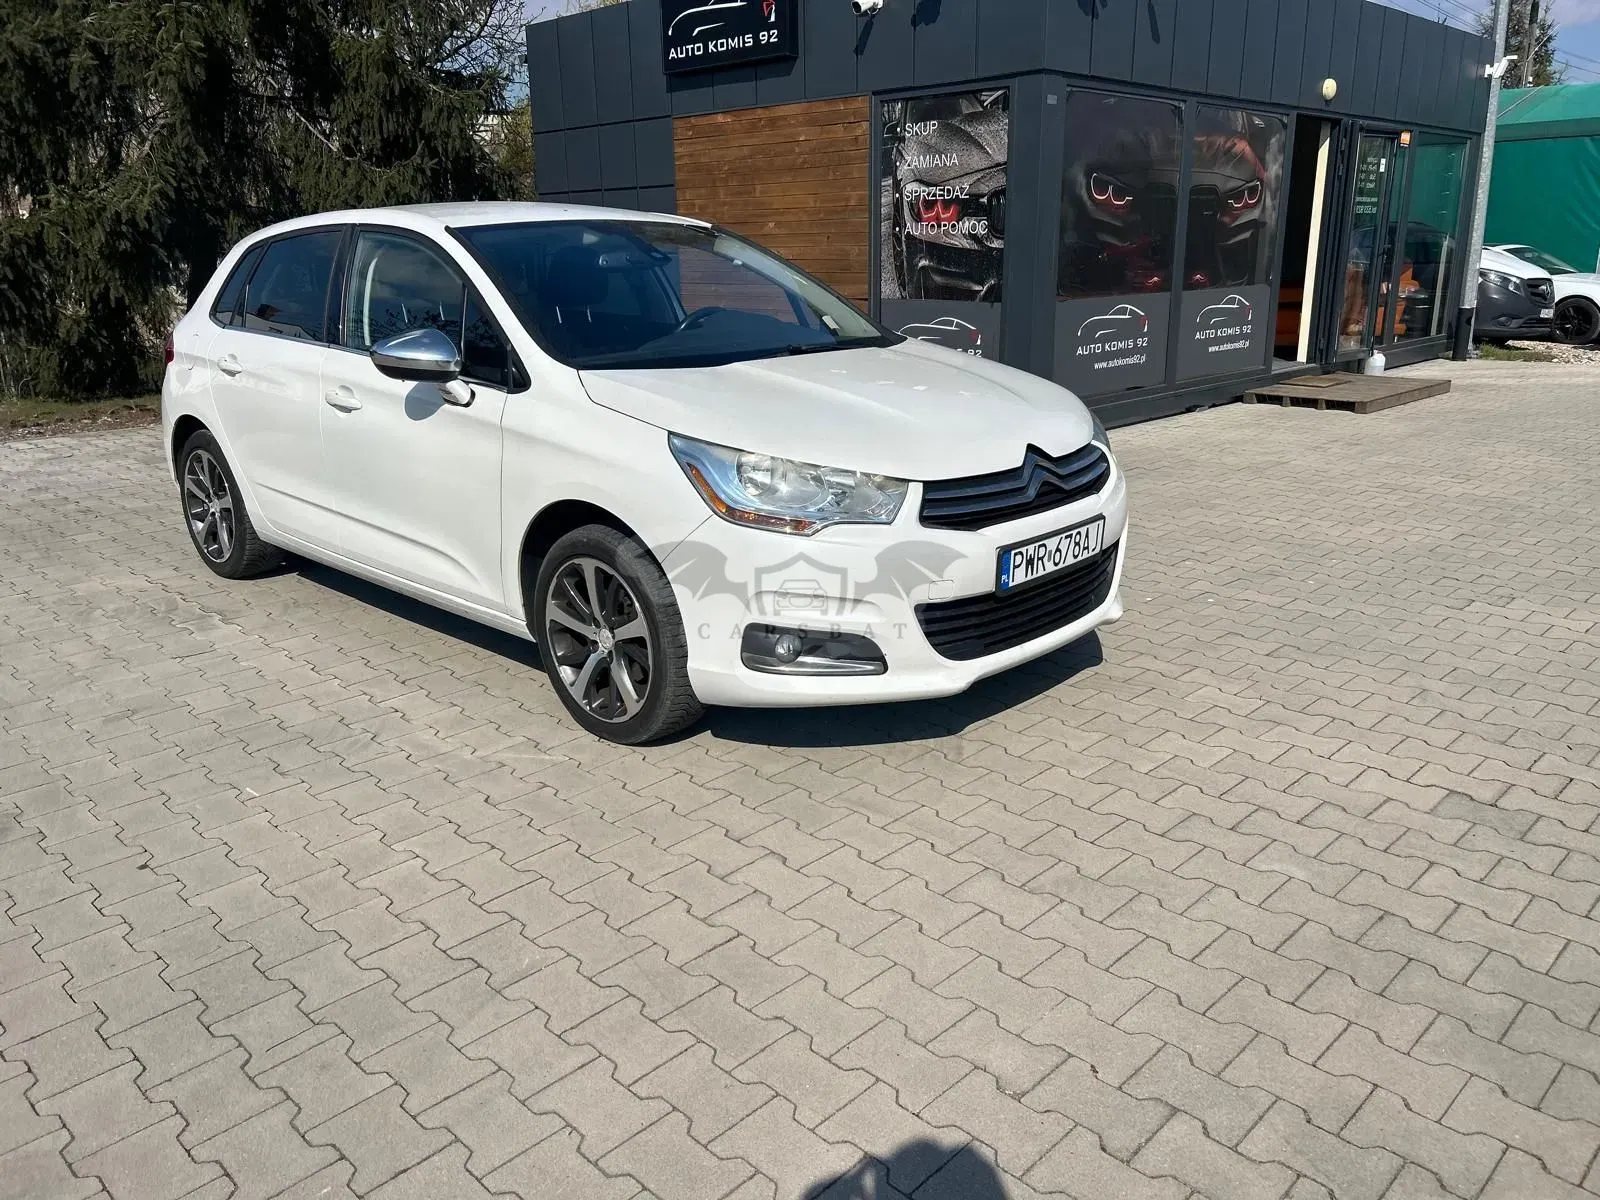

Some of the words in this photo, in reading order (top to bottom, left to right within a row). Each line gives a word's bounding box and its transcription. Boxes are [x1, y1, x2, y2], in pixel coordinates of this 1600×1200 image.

[668, 43, 704, 60] AUTO
[708, 33, 754, 54] KOMIS
[759, 29, 779, 45] 92
[905, 121, 939, 136] SKUP
[904, 153, 960, 169] ZAMIANA
[904, 221, 938, 235] AUTO
[940, 220, 989, 235] POMOC
[1195, 330, 1216, 340] AUTO
[1217, 326, 1241, 337] KOMIS
[1242, 324, 1252, 334] 92
[1076, 343, 1102, 356] AUTO
[1104, 339, 1135, 352] KOMIS
[1136, 337, 1149, 347] 92
[1093, 353, 1147, 370] www.autokomis92.pl
[1012, 542, 1047, 583] PWR
[1052, 523, 1100, 567] 678AJ
[1001, 574, 1009, 584] PL
